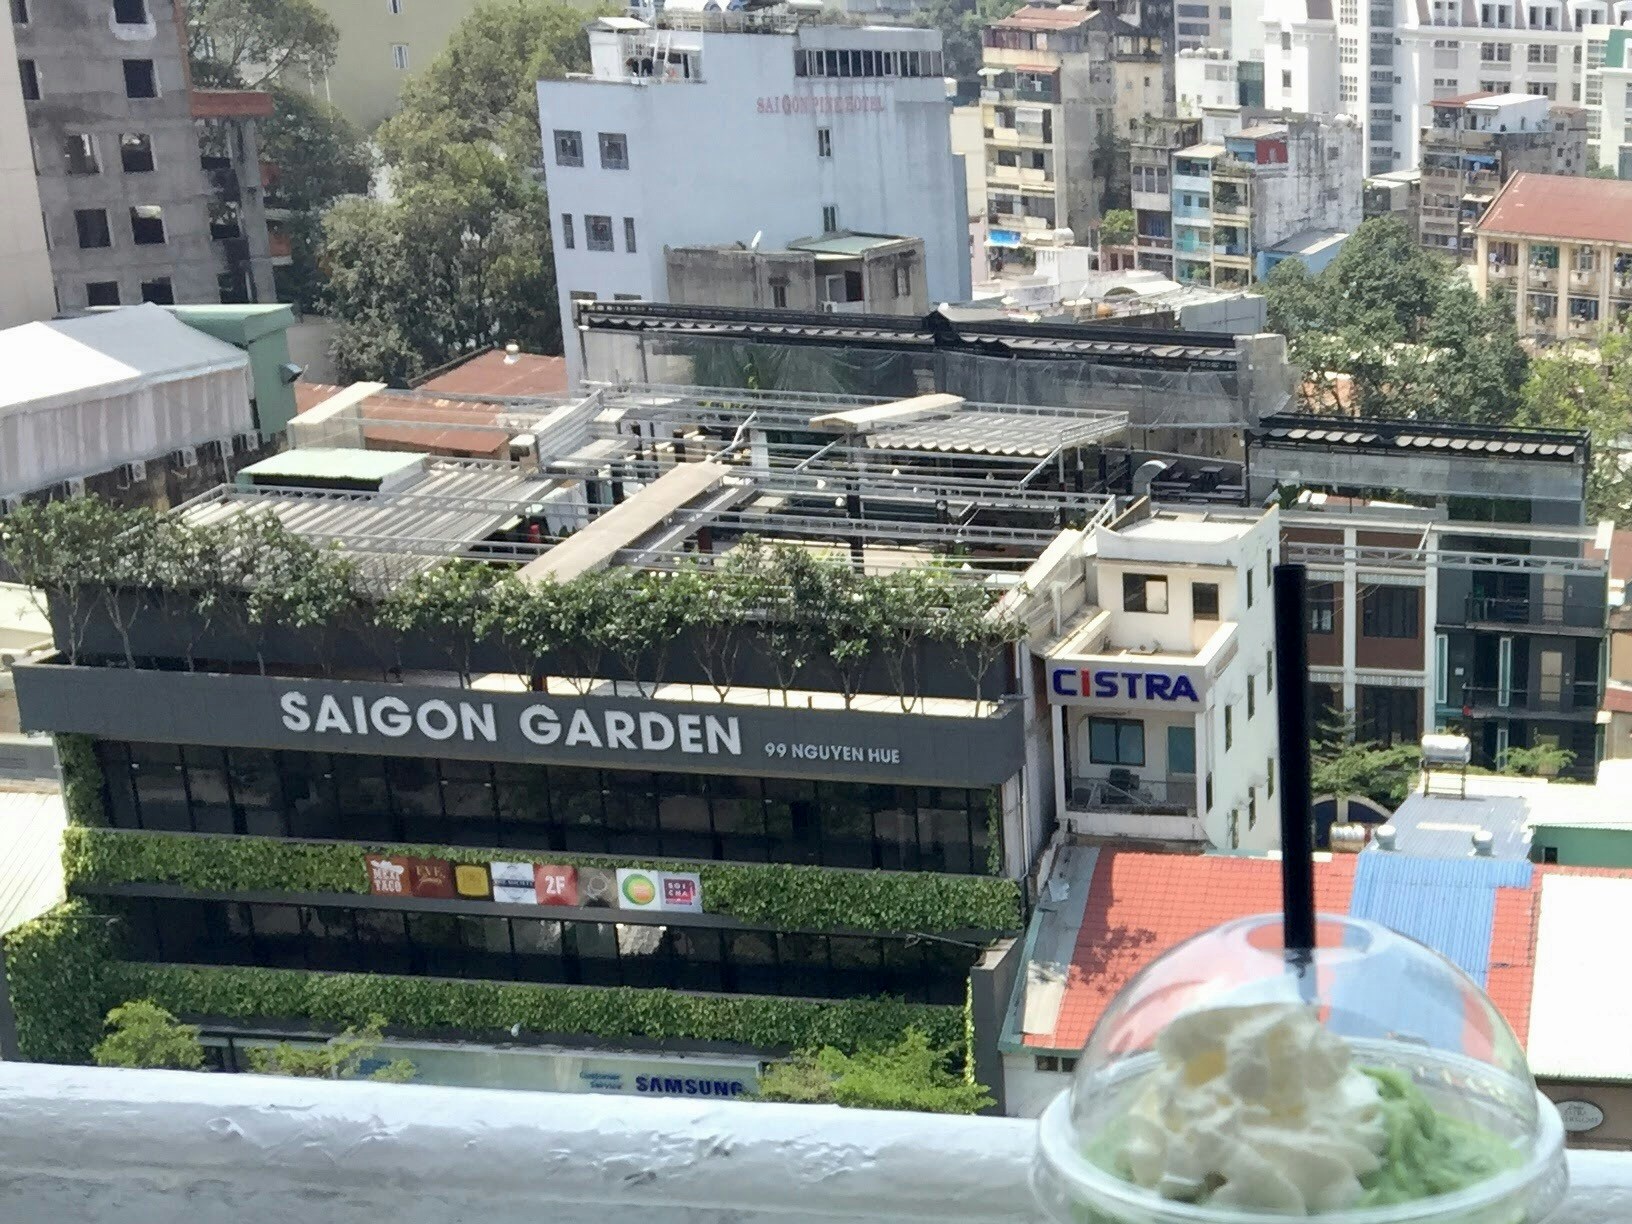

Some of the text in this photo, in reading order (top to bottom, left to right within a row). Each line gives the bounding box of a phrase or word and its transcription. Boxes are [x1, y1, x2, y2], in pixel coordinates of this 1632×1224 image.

[757, 95, 808, 114] SAIGON
[1052, 668, 1200, 702] CISTRA
[280, 690, 901, 765] SAIGON GARDEN 99 NGUYEN HUE
[374, 879, 402, 893] TACO
[544, 875, 566, 895] 2F
